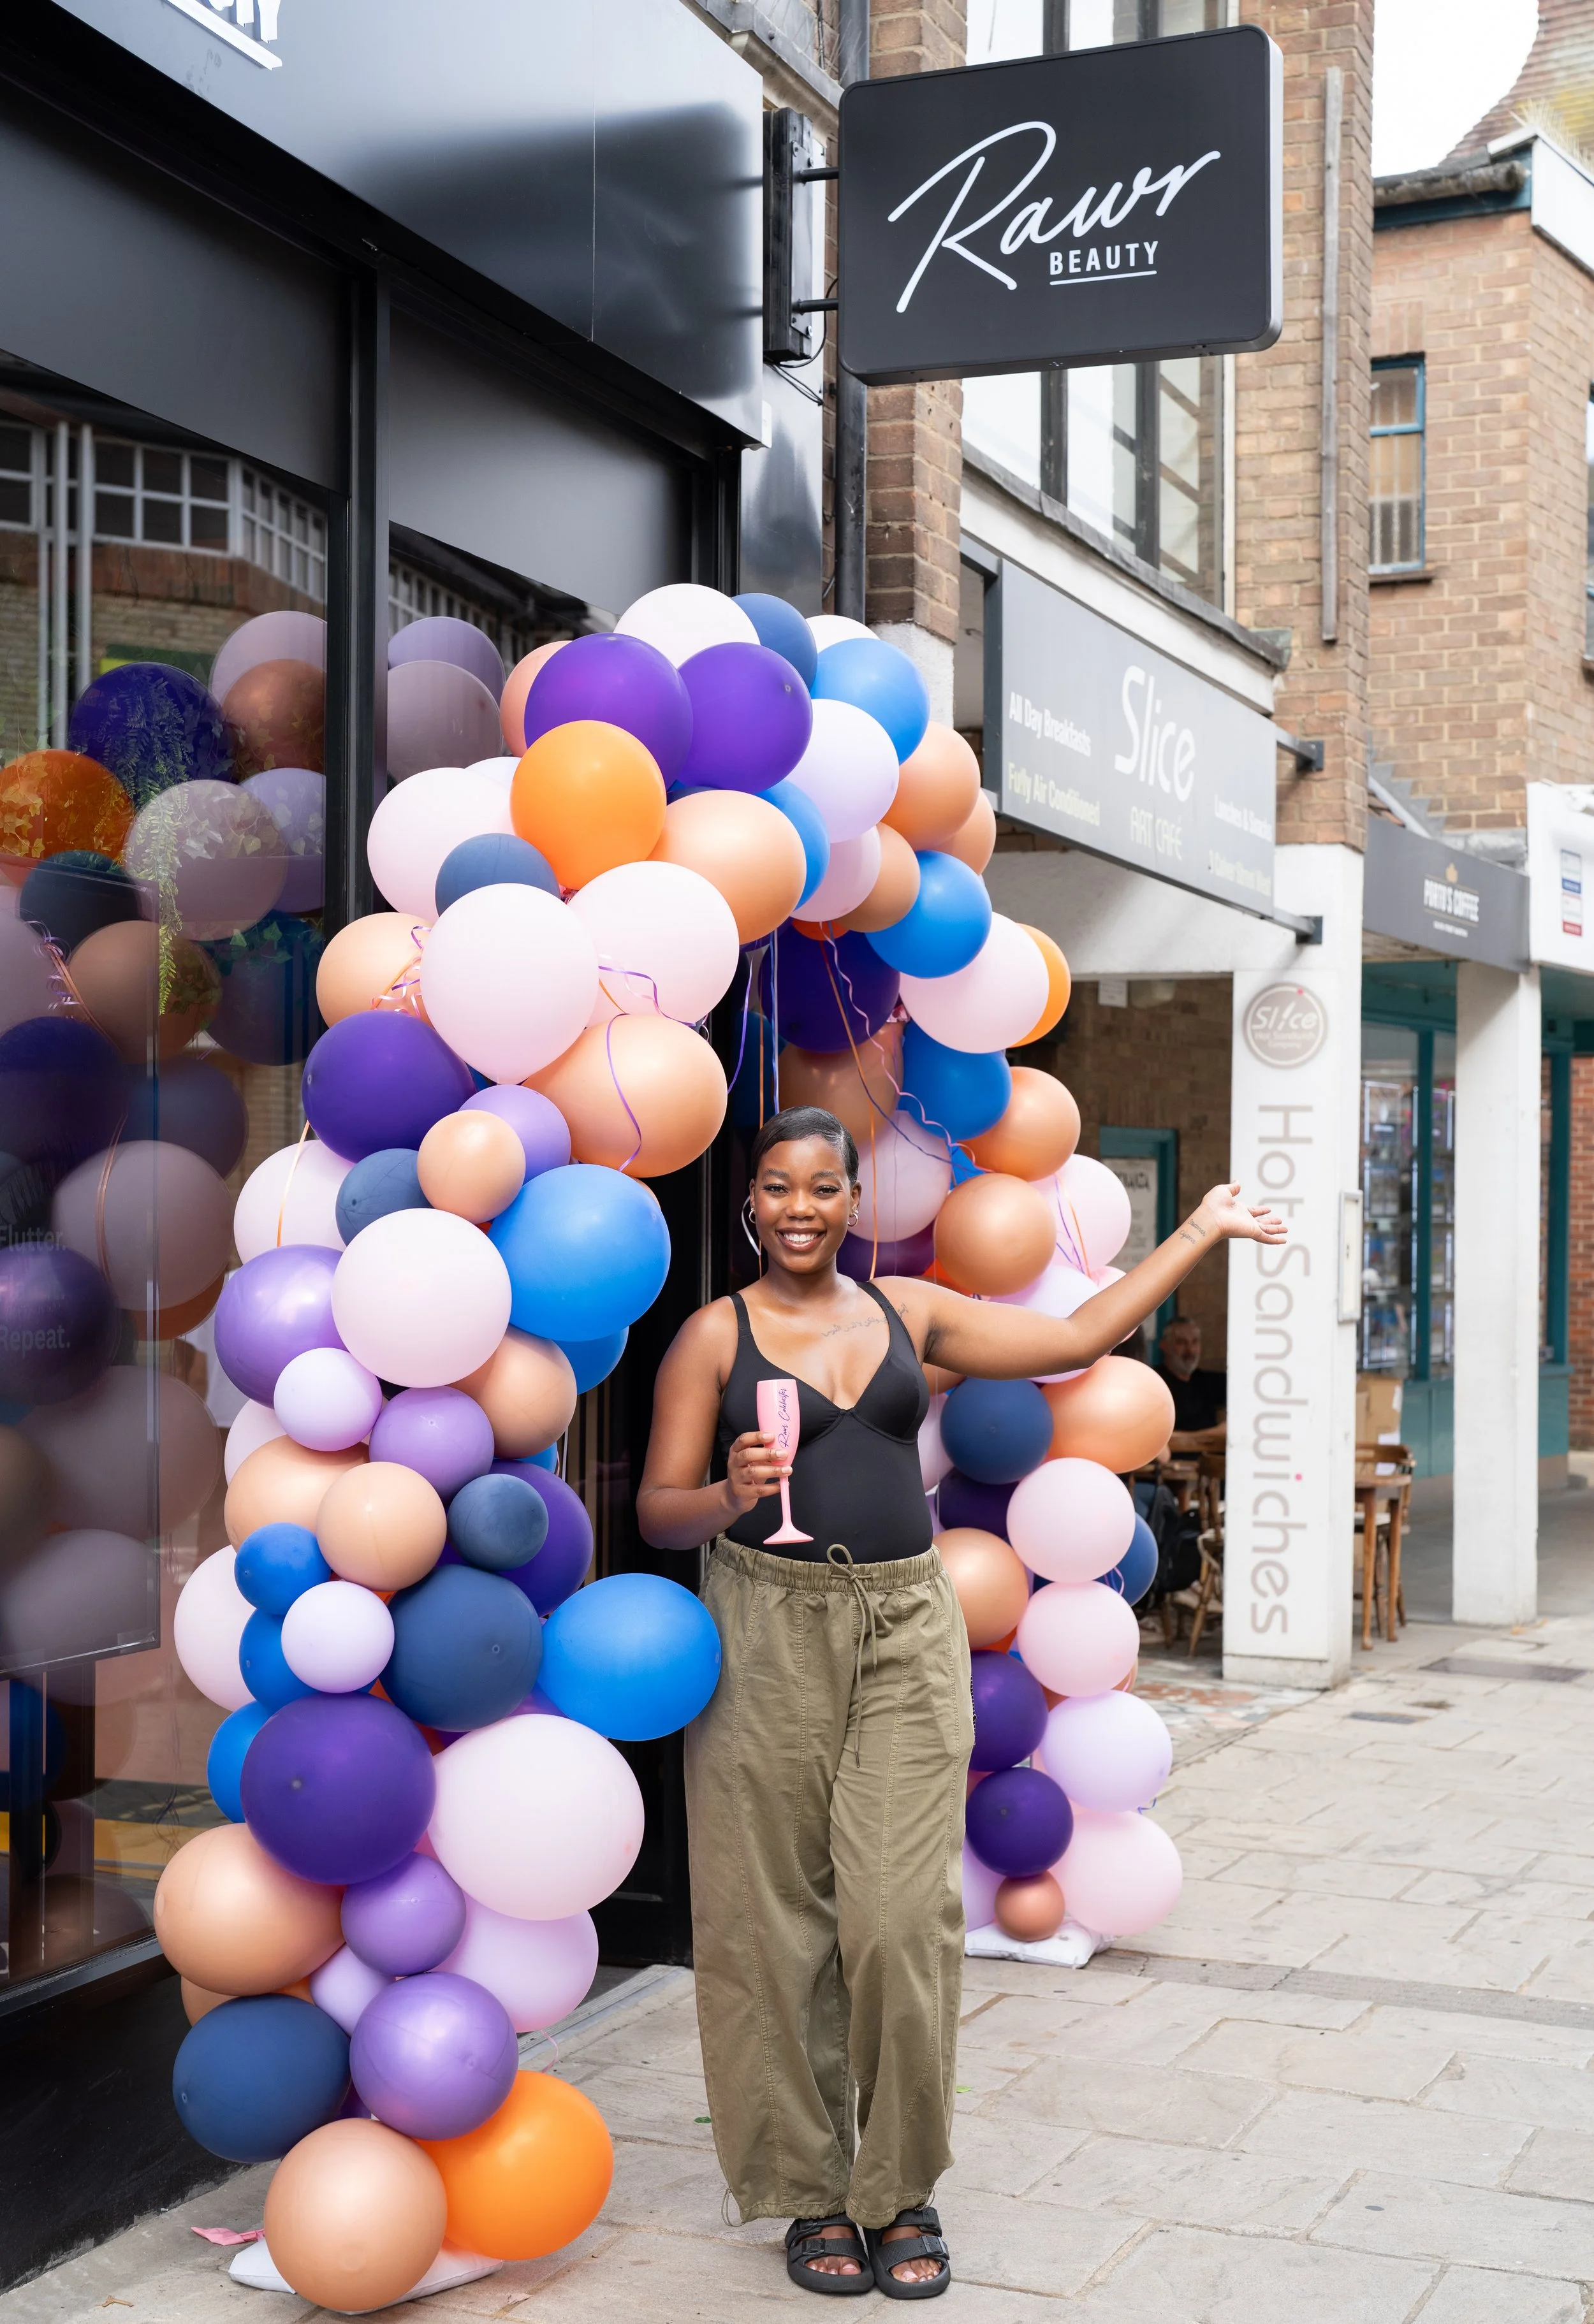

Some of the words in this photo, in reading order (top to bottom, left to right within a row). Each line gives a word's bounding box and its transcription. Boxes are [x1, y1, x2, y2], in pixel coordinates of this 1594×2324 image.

[888, 121, 1220, 312] Rawr
[1049, 241, 1159, 275] BEAUTY
[1009, 691, 1023, 724] All
[1024, 699, 1043, 739] Day
[1044, 708, 1092, 757] Breakfasts
[1115, 665, 1196, 803] Slice
[1008, 761, 1032, 804] Fully
[1033, 773, 1048, 804] Air
[1048, 779, 1100, 826] Conditioned
[1130, 806, 1153, 849] ART
[1252, 1000, 1318, 1031] Slice
[1257, 1104, 1313, 1218] Hot
[1250, 1242, 1311, 1635] Sandwiches
